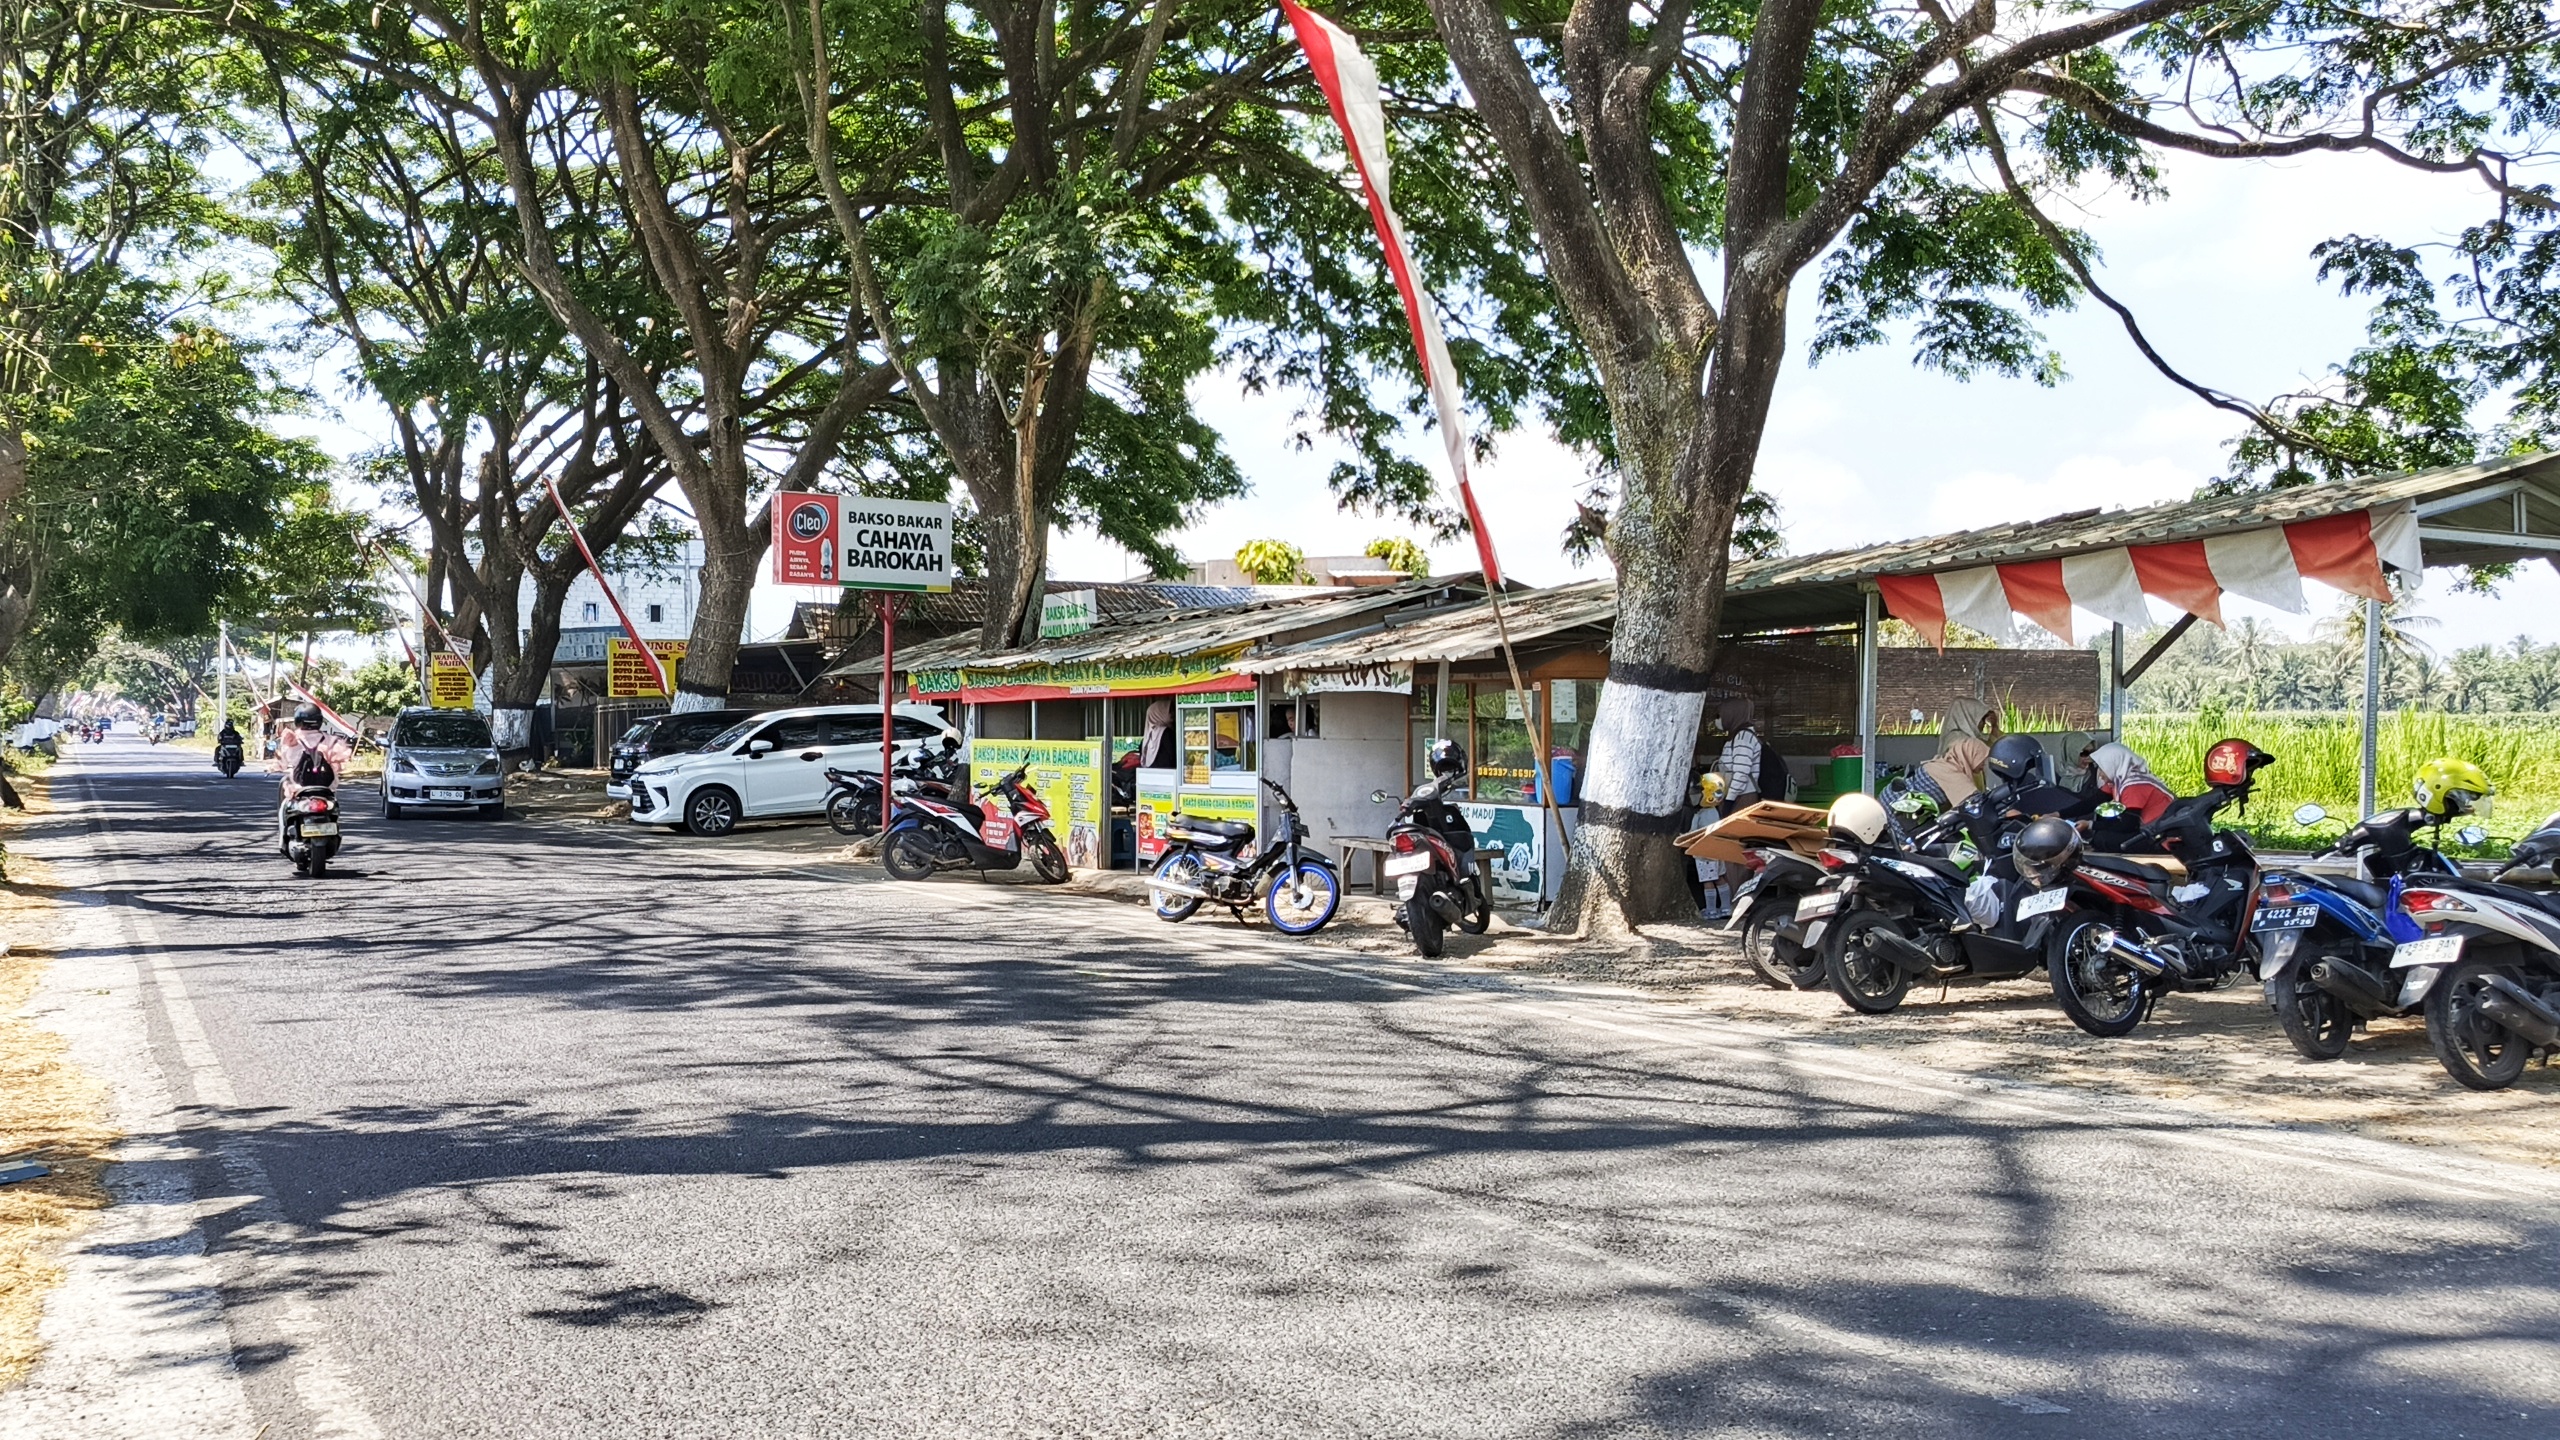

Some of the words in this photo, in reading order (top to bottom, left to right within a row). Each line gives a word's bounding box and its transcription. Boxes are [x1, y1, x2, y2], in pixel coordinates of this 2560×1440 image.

[795, 512, 822, 532] Cleo
[848, 511, 895, 527] BAKSO
[897, 514, 943, 530] BAKAR
[856, 529, 934, 552] CAHAYA
[847, 549, 943, 572] BAROKAH
[1045, 605, 1065, 621] BAKSO
[617, 641, 673, 651] WAUNG
[966, 671, 1003, 688] BAKSO
[1006, 664, 1049, 686] BAKAR
[1050, 659, 1102, 682] CAHAYA
[1104, 654, 1175, 681] BAROKAH
[915, 669, 962, 694] BAKSO
[974, 746, 995, 763] BAKSO
[997, 746, 1019, 764] BAKAR
[1052, 747, 1090, 767] BAROKAH
[1471, 808, 1494, 820] MADU
[2254, 911, 2262, 921] N
[2266, 909, 2292, 919] 4222
